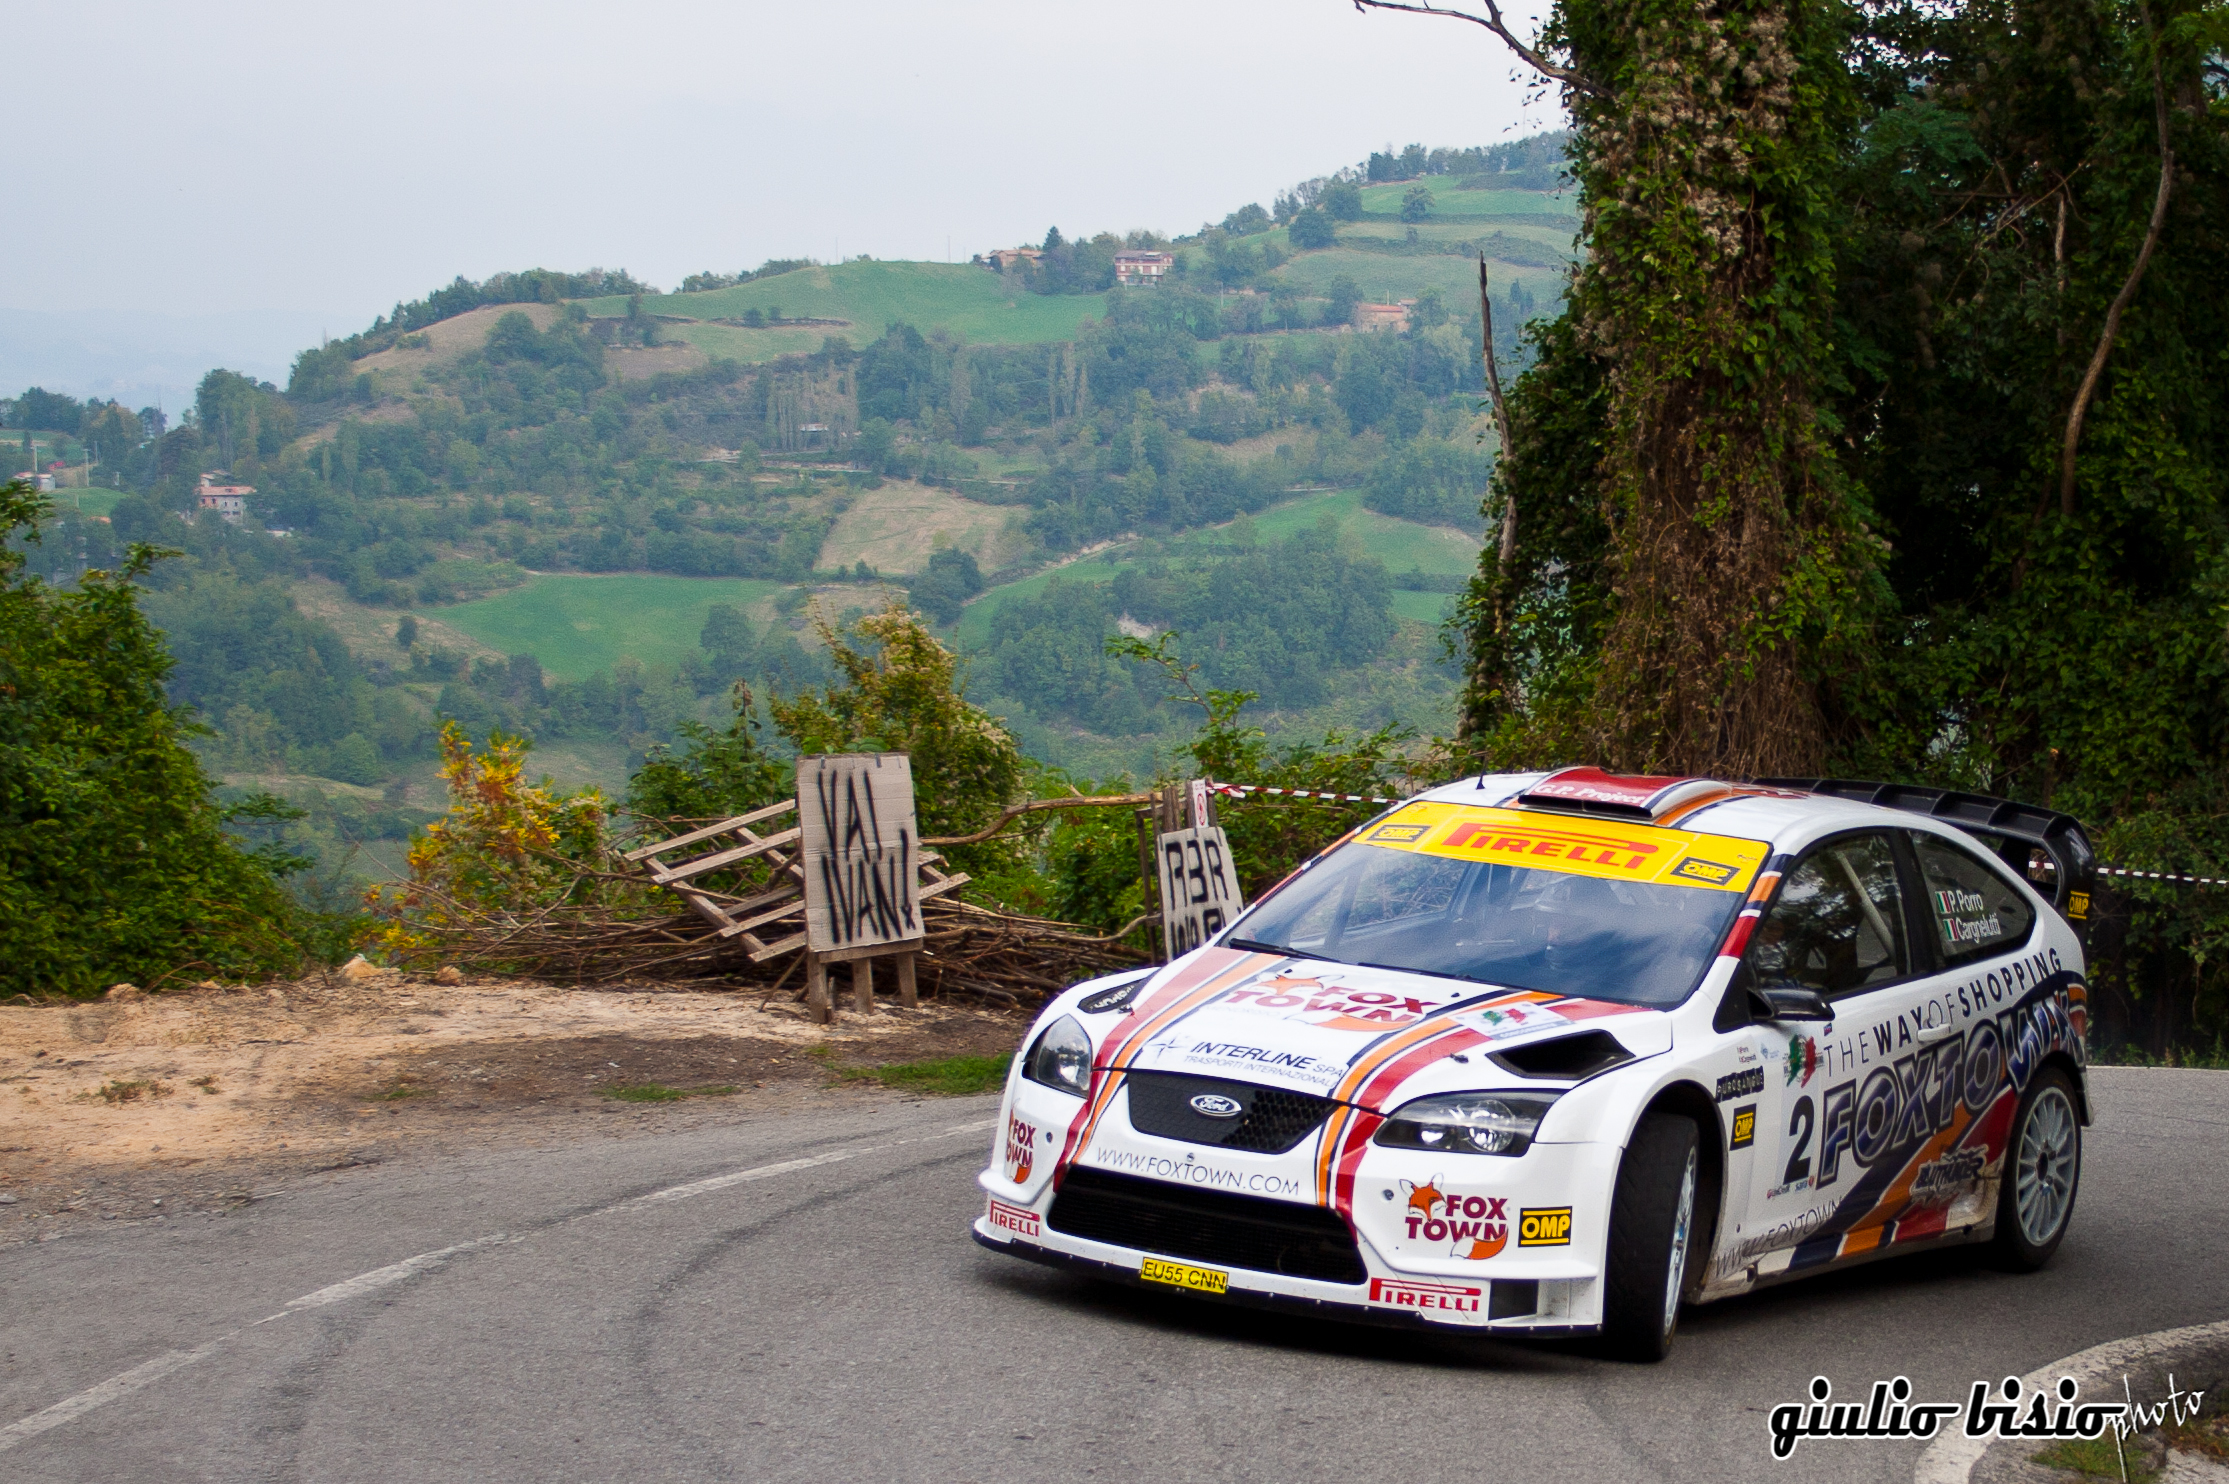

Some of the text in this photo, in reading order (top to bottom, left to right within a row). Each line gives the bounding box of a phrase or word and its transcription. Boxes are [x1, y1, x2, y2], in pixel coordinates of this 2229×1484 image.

[1575, 787, 1646, 804] Project
[818, 769, 883, 864] VAI
[1377, 827, 1421, 839] OMP
[1441, 822, 1659, 869] PIRELLI
[1683, 863, 1729, 878] OMP
[2068, 896, 2089, 915] OMP
[1225, 990, 1418, 1022] TOWN
[1313, 986, 1444, 1014] FOX
[1184, 1055, 1243, 1069] TRASPORTI
[1190, 1042, 1344, 1078] INTERLINE SPA
[1198, 1097, 1230, 1111] Ford
[1013, 1119, 1036, 1149] FOX
[1735, 1117, 1753, 1137] OMP
[1783, 1095, 1814, 1186] 2
[1099, 1147, 1299, 1196] WWW.FOXTOWN.COM
[990, 1200, 1040, 1237] PIRELLI
[1445, 1194, 1509, 1221] FOX
[1405, 1216, 1508, 1243] TOWN
[1522, 1214, 1571, 1239] OMP
[1143, 1261, 1228, 1291] EU55 CNN
[1369, 1277, 1482, 1312] PIRELLI
